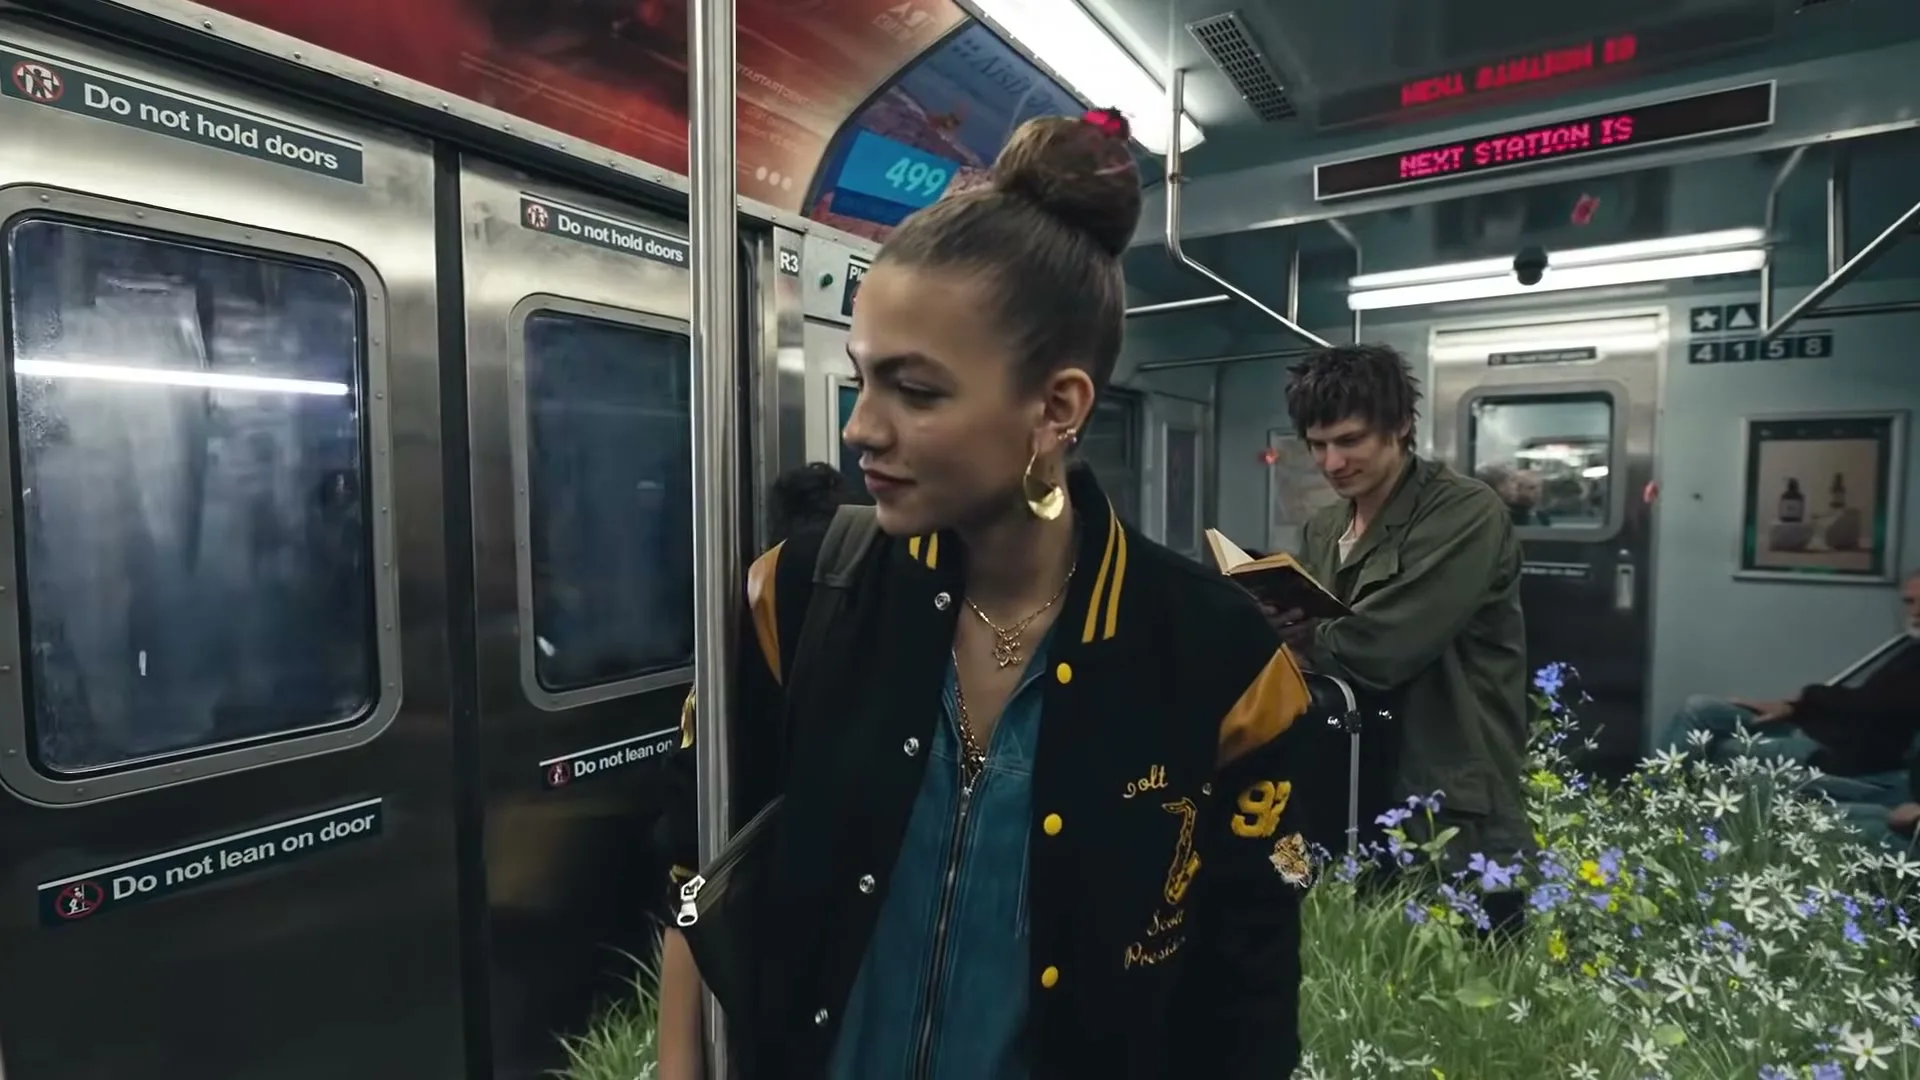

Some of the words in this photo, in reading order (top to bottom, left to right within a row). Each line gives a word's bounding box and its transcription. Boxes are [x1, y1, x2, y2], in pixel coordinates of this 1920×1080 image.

[84, 82, 131, 115] Do
[140, 103, 190, 132] not
[197, 113, 259, 149] hold
[265, 135, 339, 170] doors
[1400, 146, 1464, 178] NEXT
[1474, 123, 1590, 165] STATION
[1601, 116, 1633, 145] IS
[885, 157, 946, 197] 499
[558, 214, 581, 234] Do
[584, 225, 609, 243] not
[611, 229, 643, 251] hold
[645, 240, 683, 262] doors
[780, 251, 799, 273] R3
[574, 760, 597, 777] Do
[599, 751, 623, 770] not
[625, 744, 654, 763] lean
[112, 875, 158, 900] Do
[165, 855, 214, 886] not
[219, 842, 275, 870] lean
[281, 832, 314, 852] on
[319, 814, 375, 842] door
